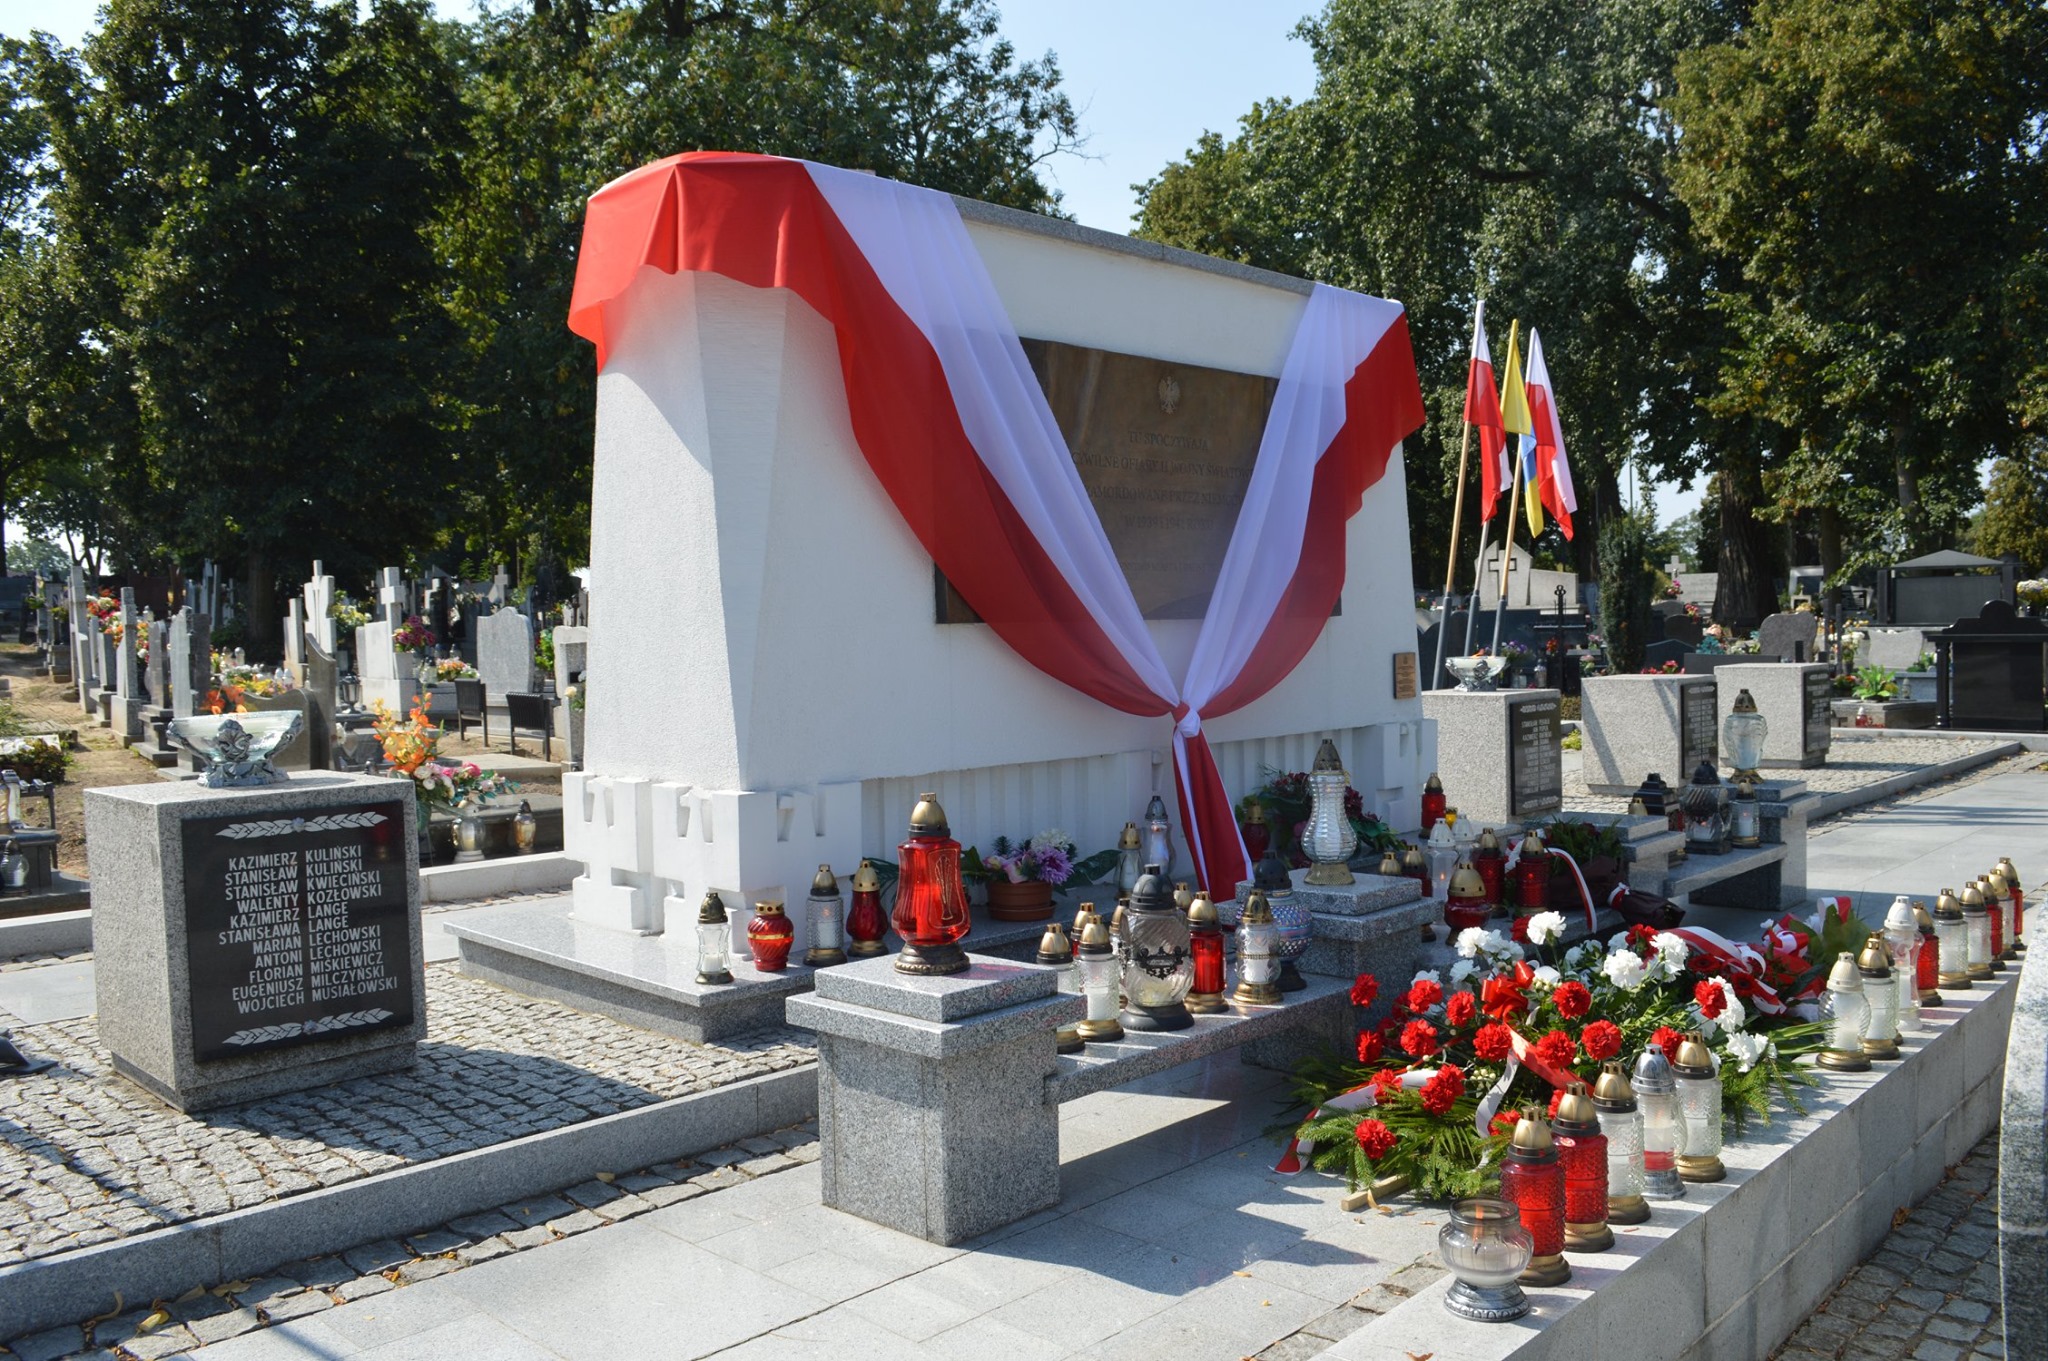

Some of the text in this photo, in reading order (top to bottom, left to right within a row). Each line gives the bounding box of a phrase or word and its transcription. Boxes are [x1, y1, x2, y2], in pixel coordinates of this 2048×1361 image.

[225, 859, 362, 886] STANISŁAW KULIŃSKI
[229, 845, 361, 871] KAZIMIERZ KULIŃSKI
[226, 871, 380, 900] STANISŁAW KWIECIŃSKI
[237, 884, 382, 914] WALENTY KOZŁOWSKI
[219, 916, 349, 944] STANISŁAWA LANGE
[230, 902, 348, 929] KAZIMIERZ LANGE
[253, 925, 381, 954] MARIAN LECHOWSKI
[255, 939, 382, 968] ANTONI LECHOWSKI
[250, 952, 383, 983] FLORIAN MIŚKIEWICZ
[232, 966, 384, 1001] EUGENIUSZ MILCZYŃSKI
[238, 977, 397, 1014] WOJCIECH MUSIAŁOWSKI
